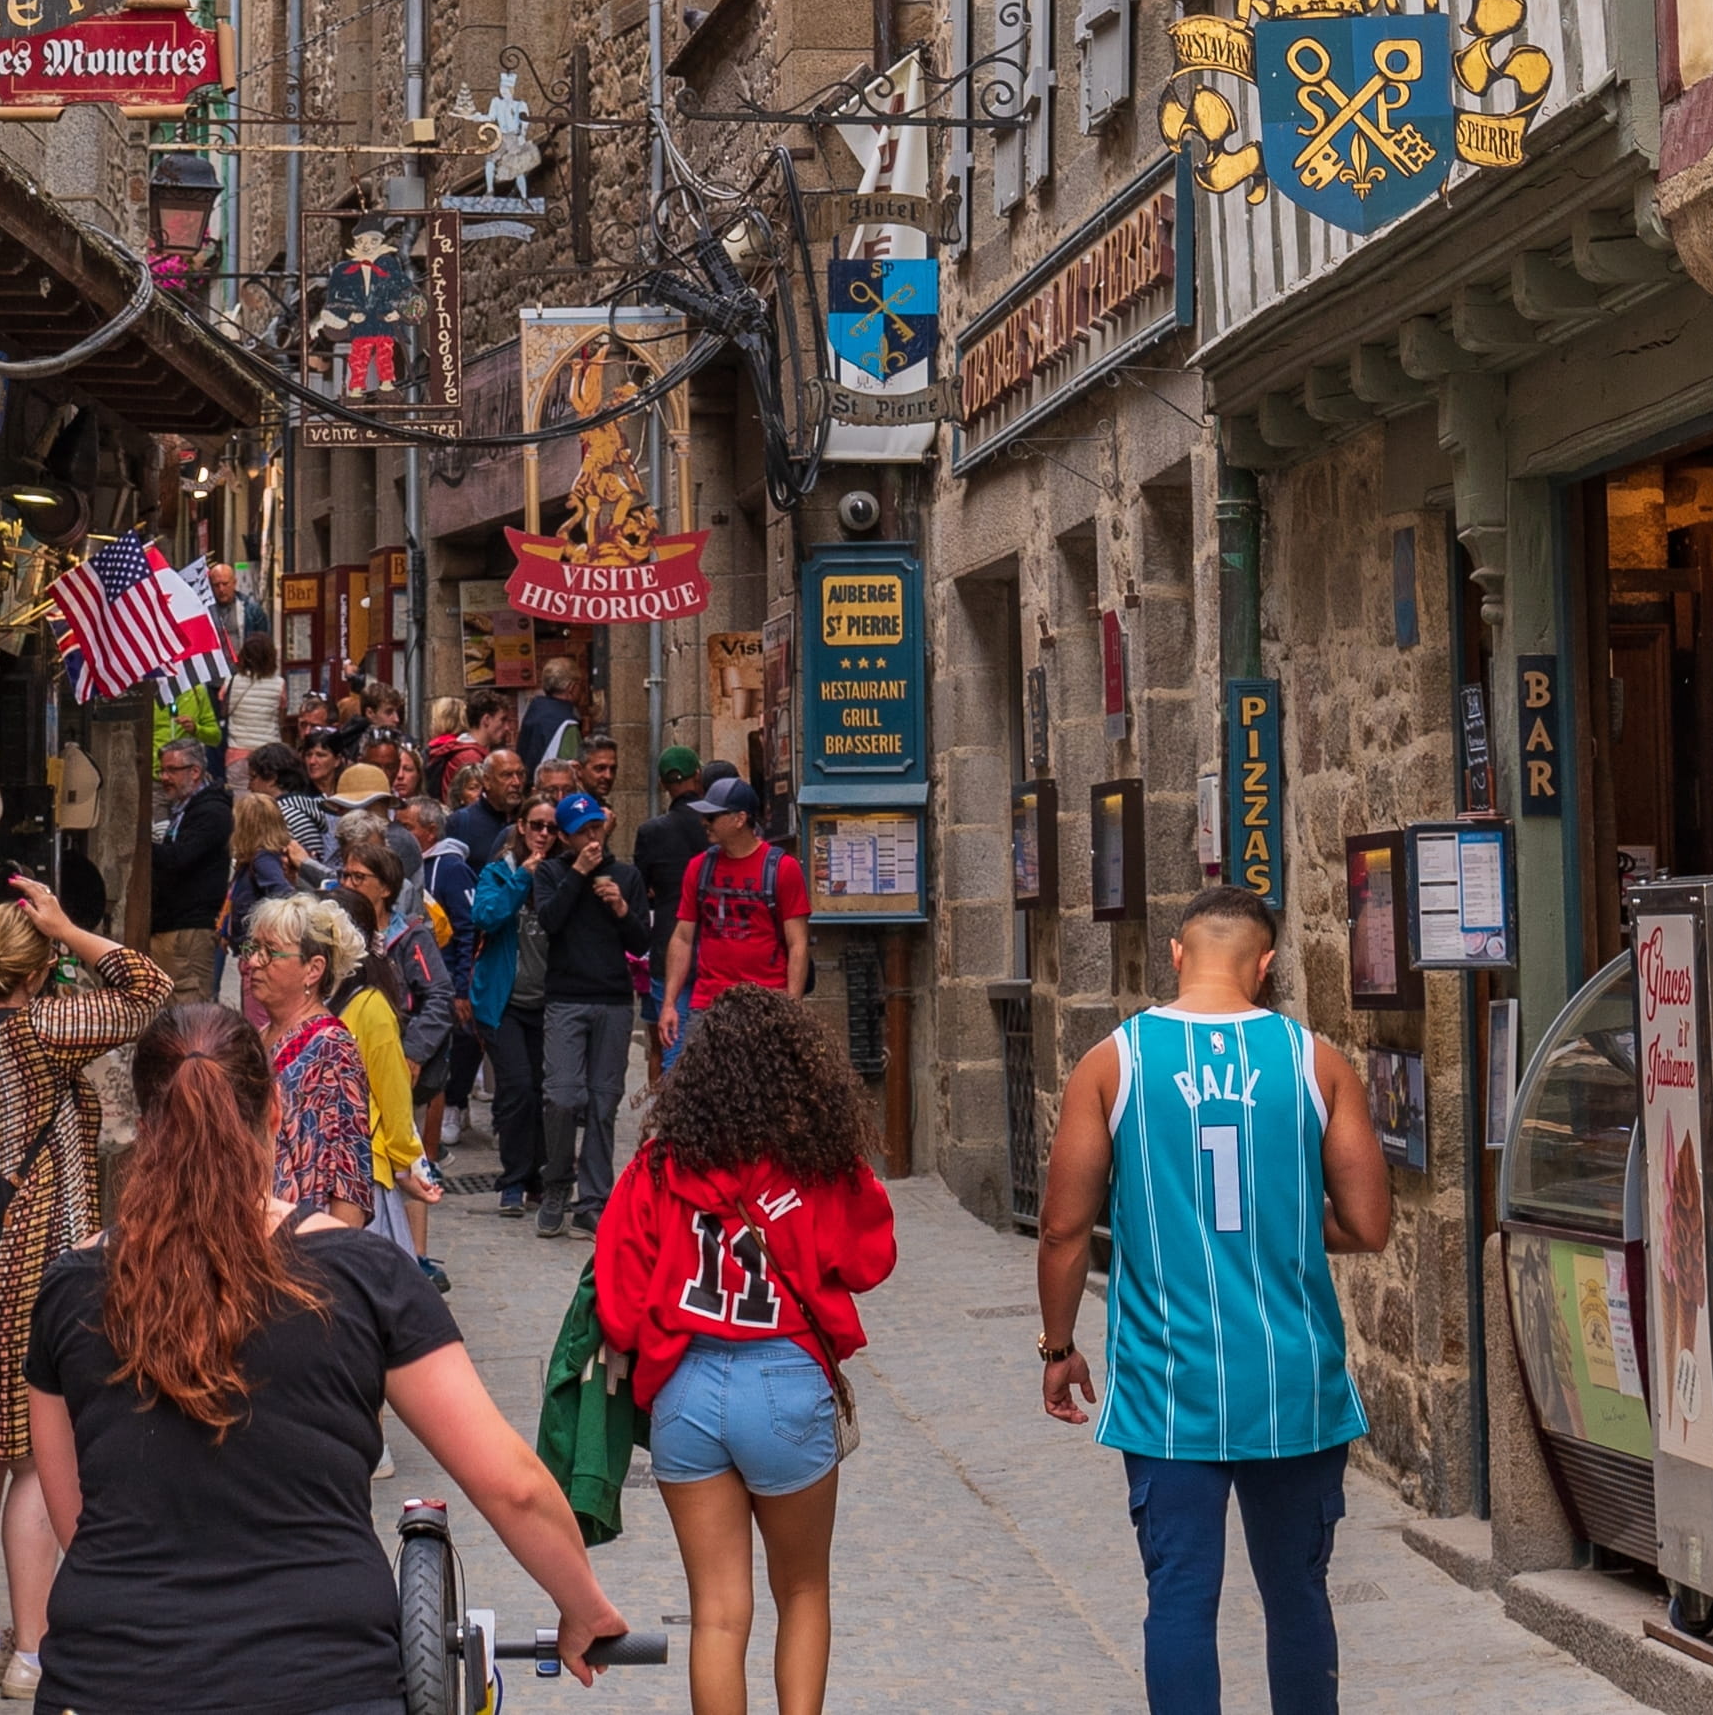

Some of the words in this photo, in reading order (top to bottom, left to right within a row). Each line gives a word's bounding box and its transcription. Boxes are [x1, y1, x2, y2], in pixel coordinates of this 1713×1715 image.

[43, 38, 207, 79] Mouettes
[848, 197, 918, 224] Hotel
[432, 218, 455, 253] La
[1088, 193, 1173, 328] PIERRE
[832, 392, 859, 416] St
[875, 398, 938, 421] Pierre
[562, 564, 661, 591] VISITE
[828, 584, 897, 605] AUBERGE
[519, 582, 703, 621] HISTORIQUE
[847, 615, 901, 637] PIERRE
[821, 680, 908, 701] RESTAURANT
[843, 707, 883, 728] GRILL
[1523, 671, 1556, 797] BAR
[825, 733, 903, 755] BRASSERIE
[1240, 695, 1272, 896] PIZZAS
[1639, 925, 1692, 1022] Glaces
[1172, 1062, 1262, 1109] BALL
[1199, 1124, 1243, 1233] 1
[679, 1210, 781, 1330] 11
